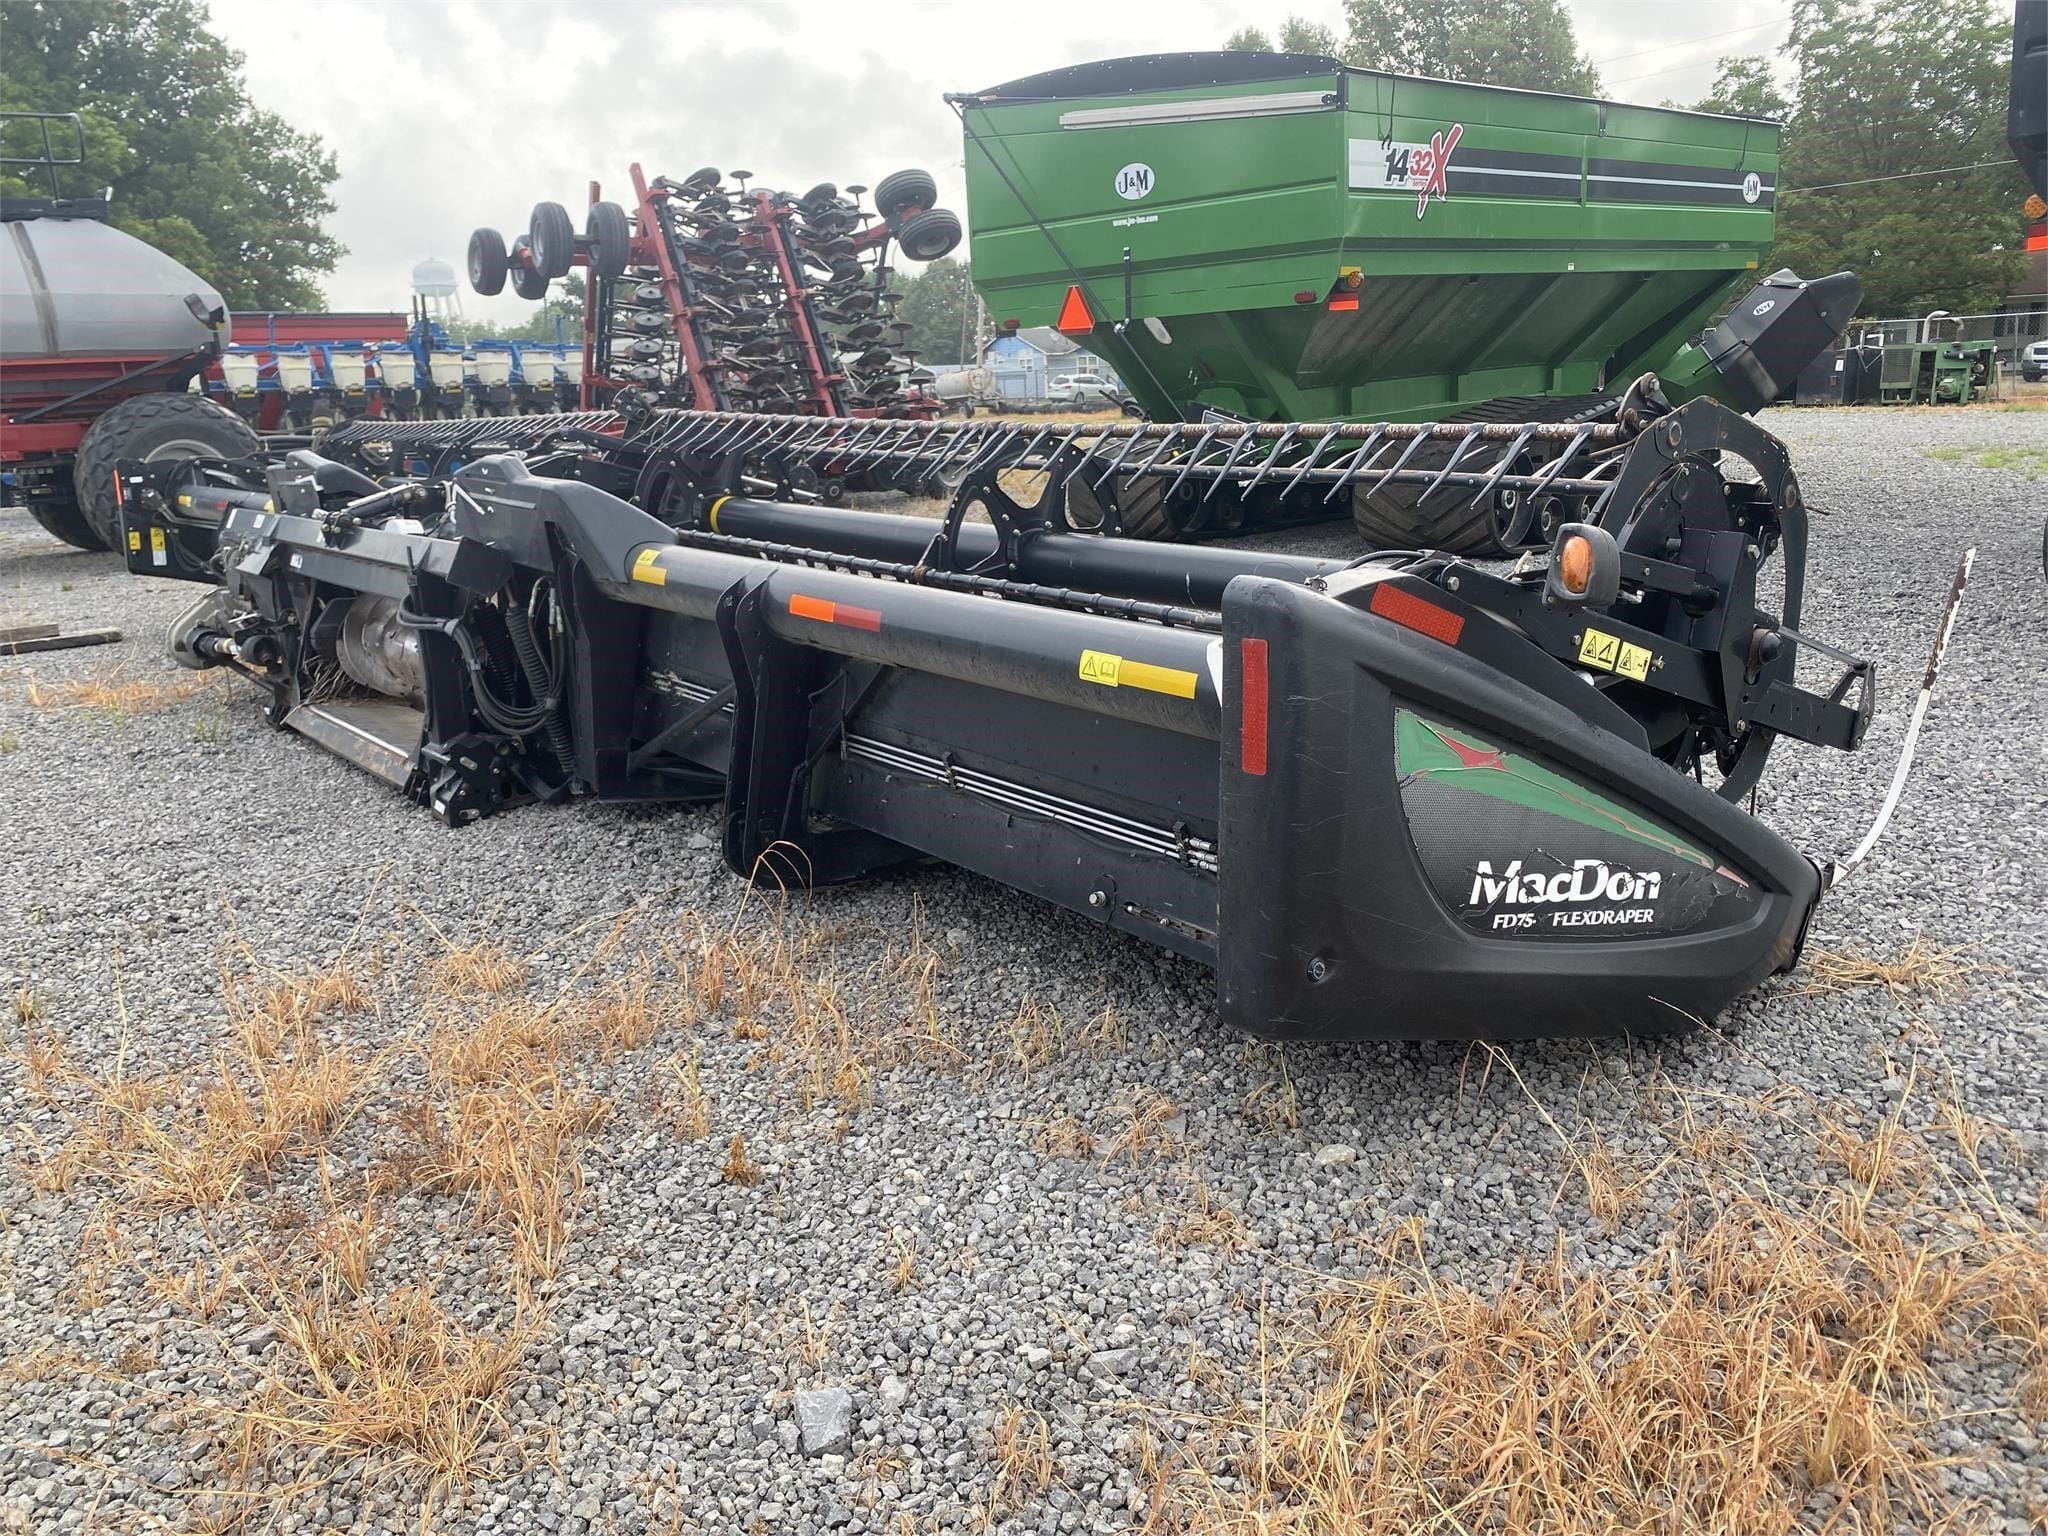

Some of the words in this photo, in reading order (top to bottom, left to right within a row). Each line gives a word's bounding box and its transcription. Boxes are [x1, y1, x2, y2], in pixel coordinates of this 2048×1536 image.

[1118, 169, 1148, 194] J&M
[1744, 179, 1758, 196] J&M
[1469, 859, 1661, 904] MacDon
[1552, 909, 1654, 926] FLEXDRAPER
